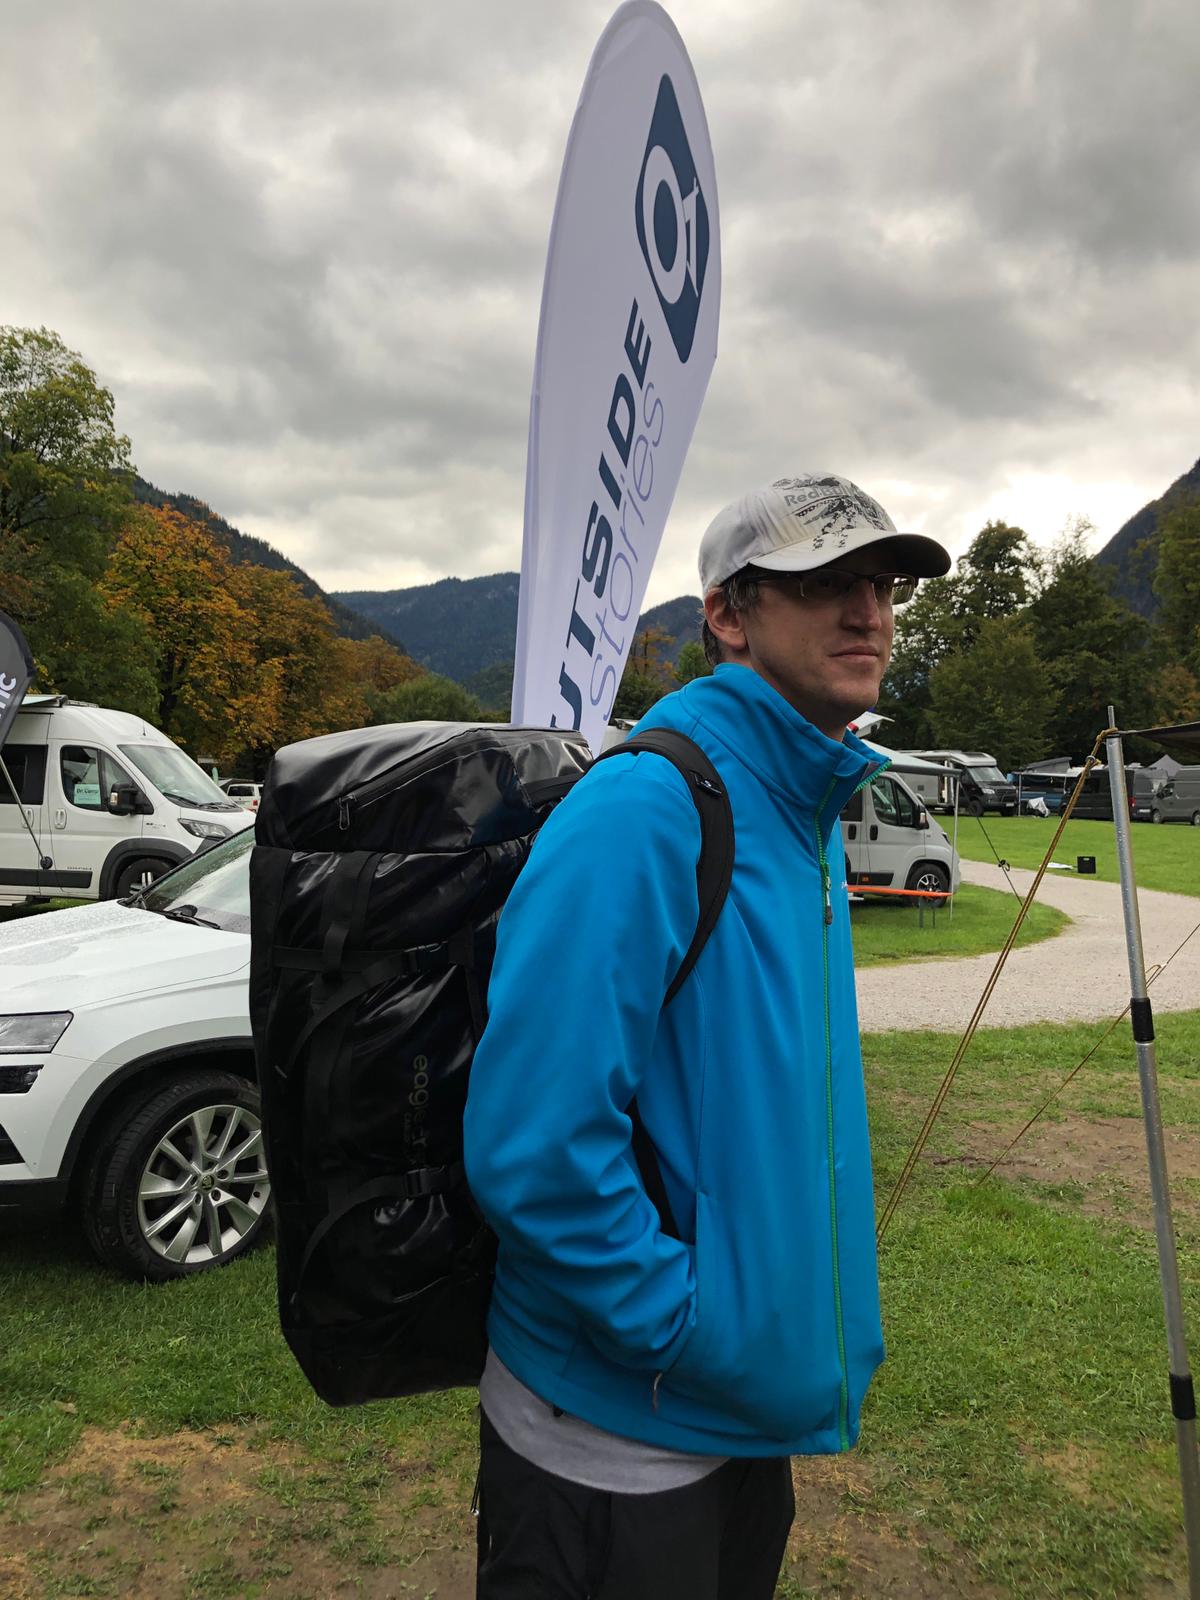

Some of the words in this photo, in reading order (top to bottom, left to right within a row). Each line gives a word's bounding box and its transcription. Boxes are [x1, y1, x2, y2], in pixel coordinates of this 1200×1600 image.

[550, 297, 651, 730] UTSIDE
[590, 381, 664, 721] stories
[785, 488, 820, 506] Red
[408, 1054, 430, 1121] eagle
